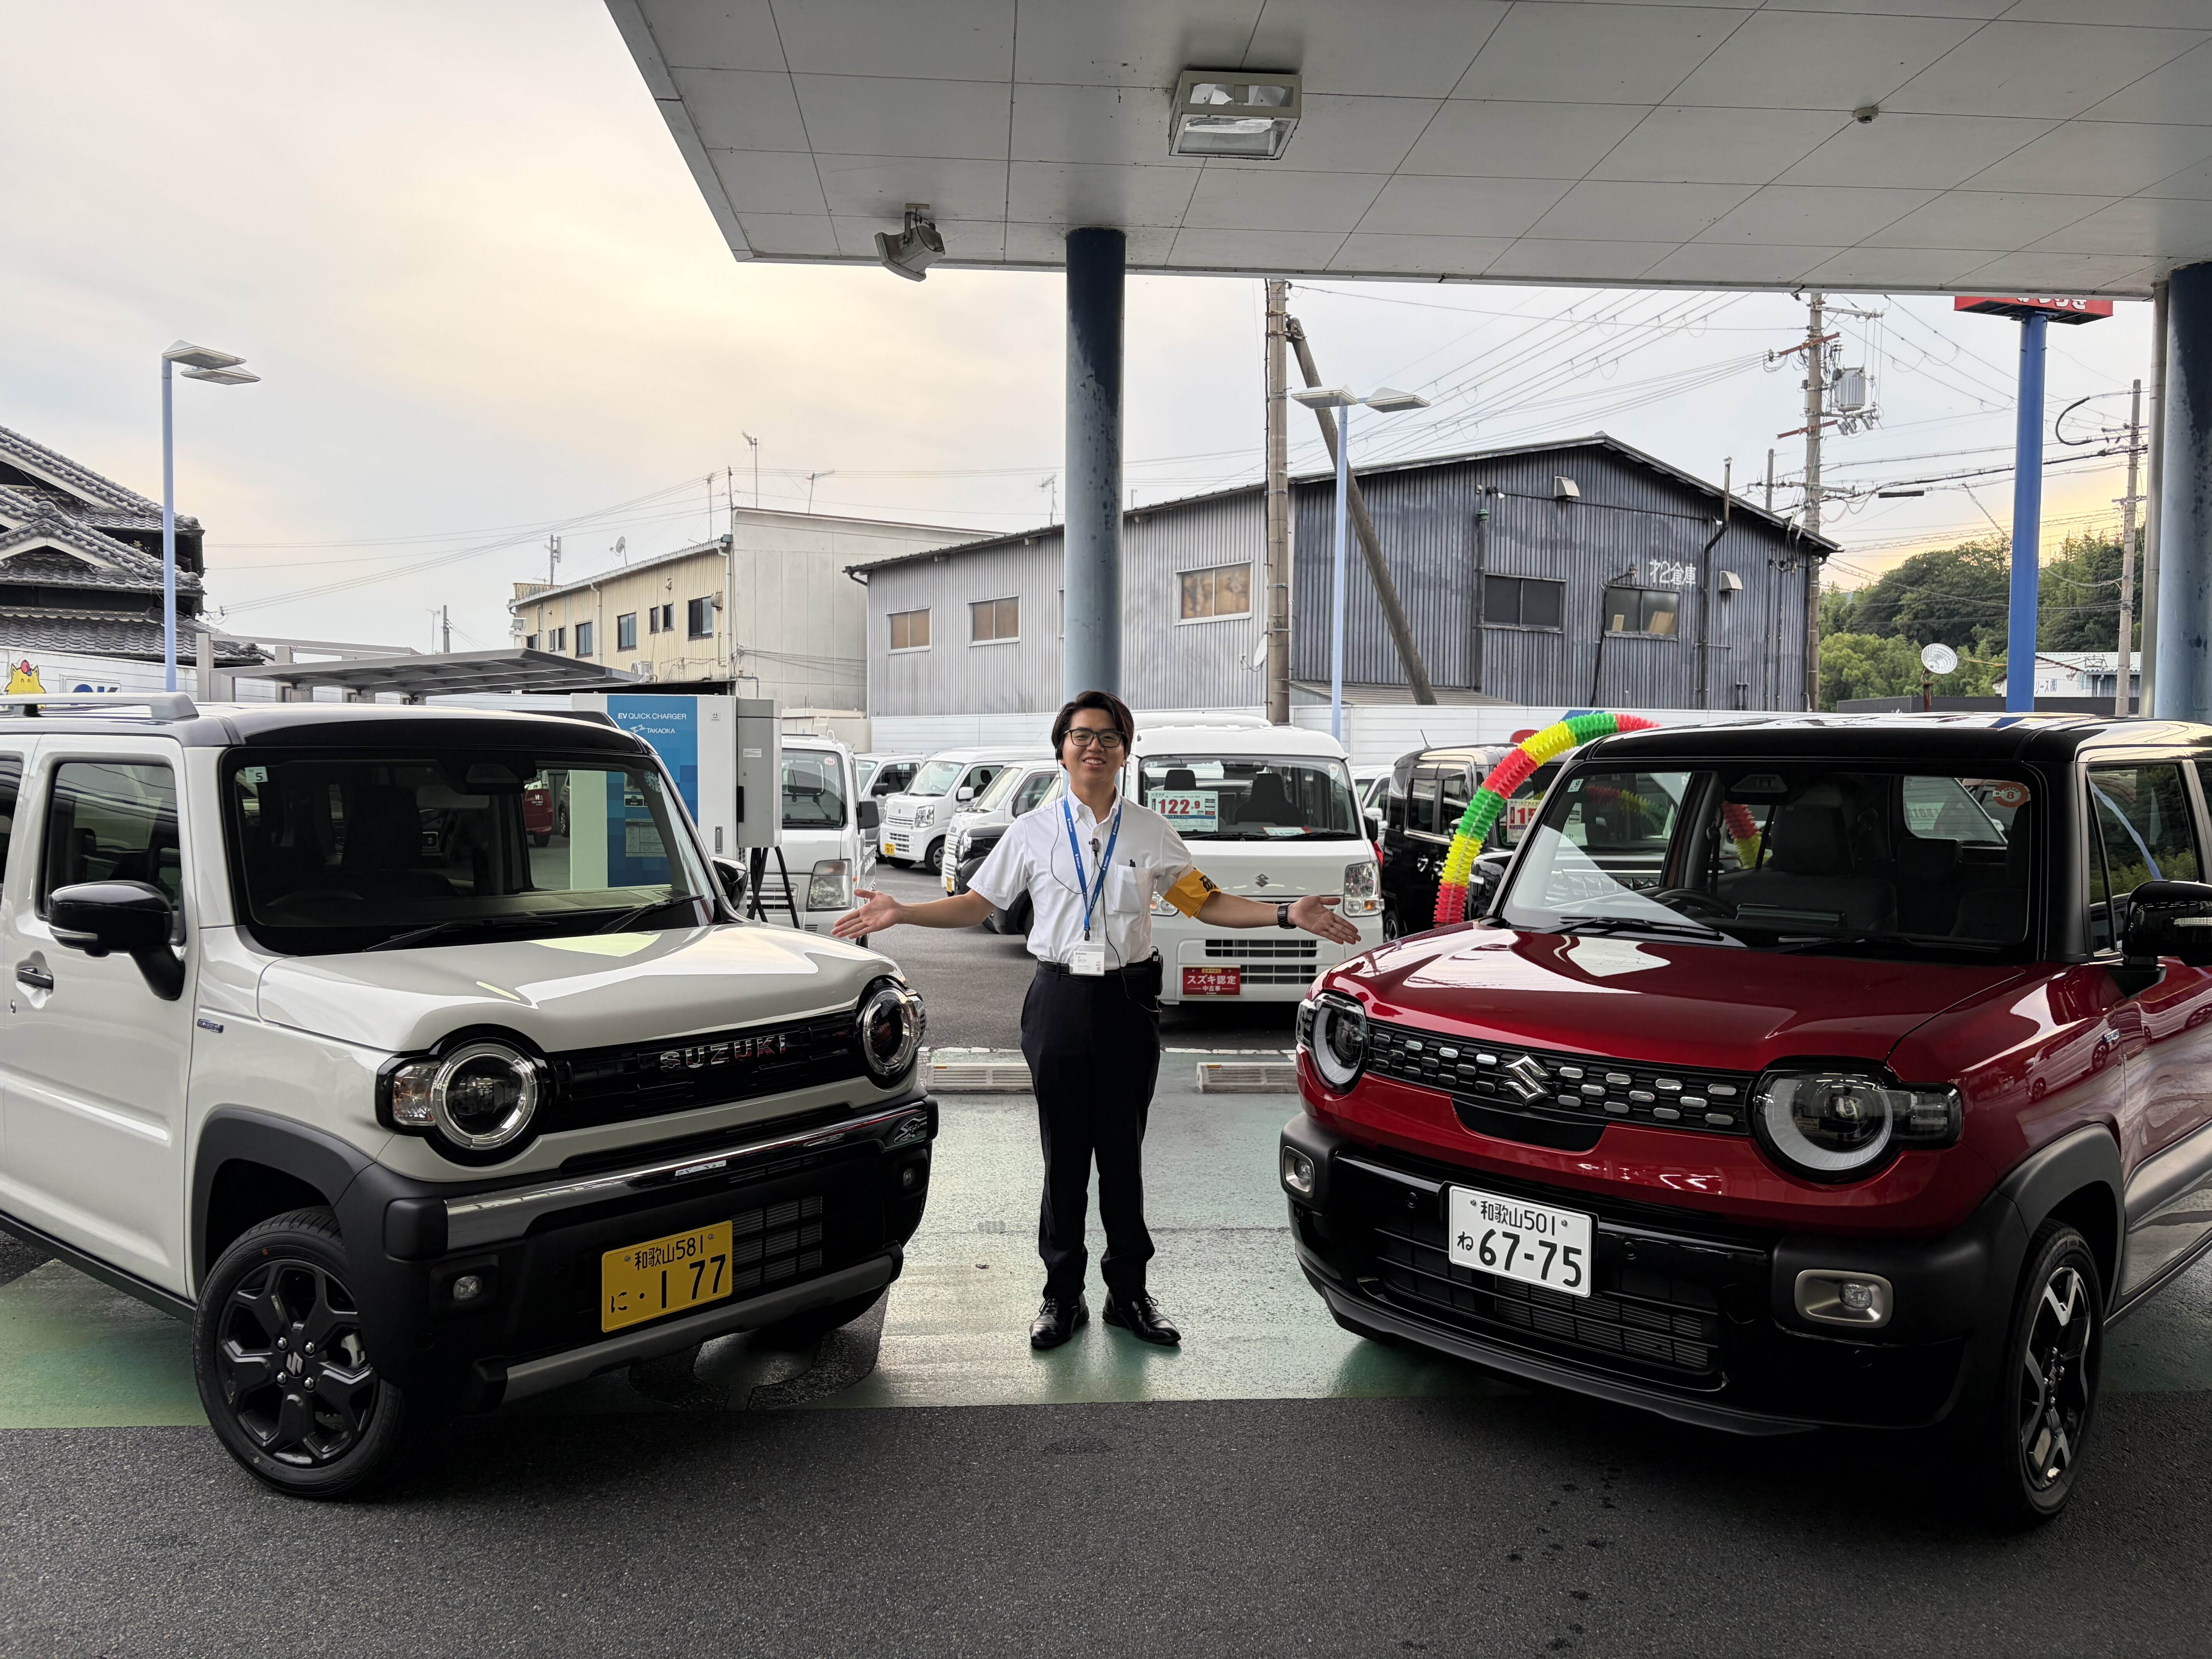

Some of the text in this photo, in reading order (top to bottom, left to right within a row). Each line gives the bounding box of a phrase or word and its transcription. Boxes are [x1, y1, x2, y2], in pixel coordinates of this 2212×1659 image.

[256, 773, 263, 781] 5
[1158, 799, 1200, 814] 122.9
[1187, 974, 1236, 984] スズキ認定
[660, 1035, 786, 1072] SUZUKI
[1479, 1228, 1582, 1288] 67-75
